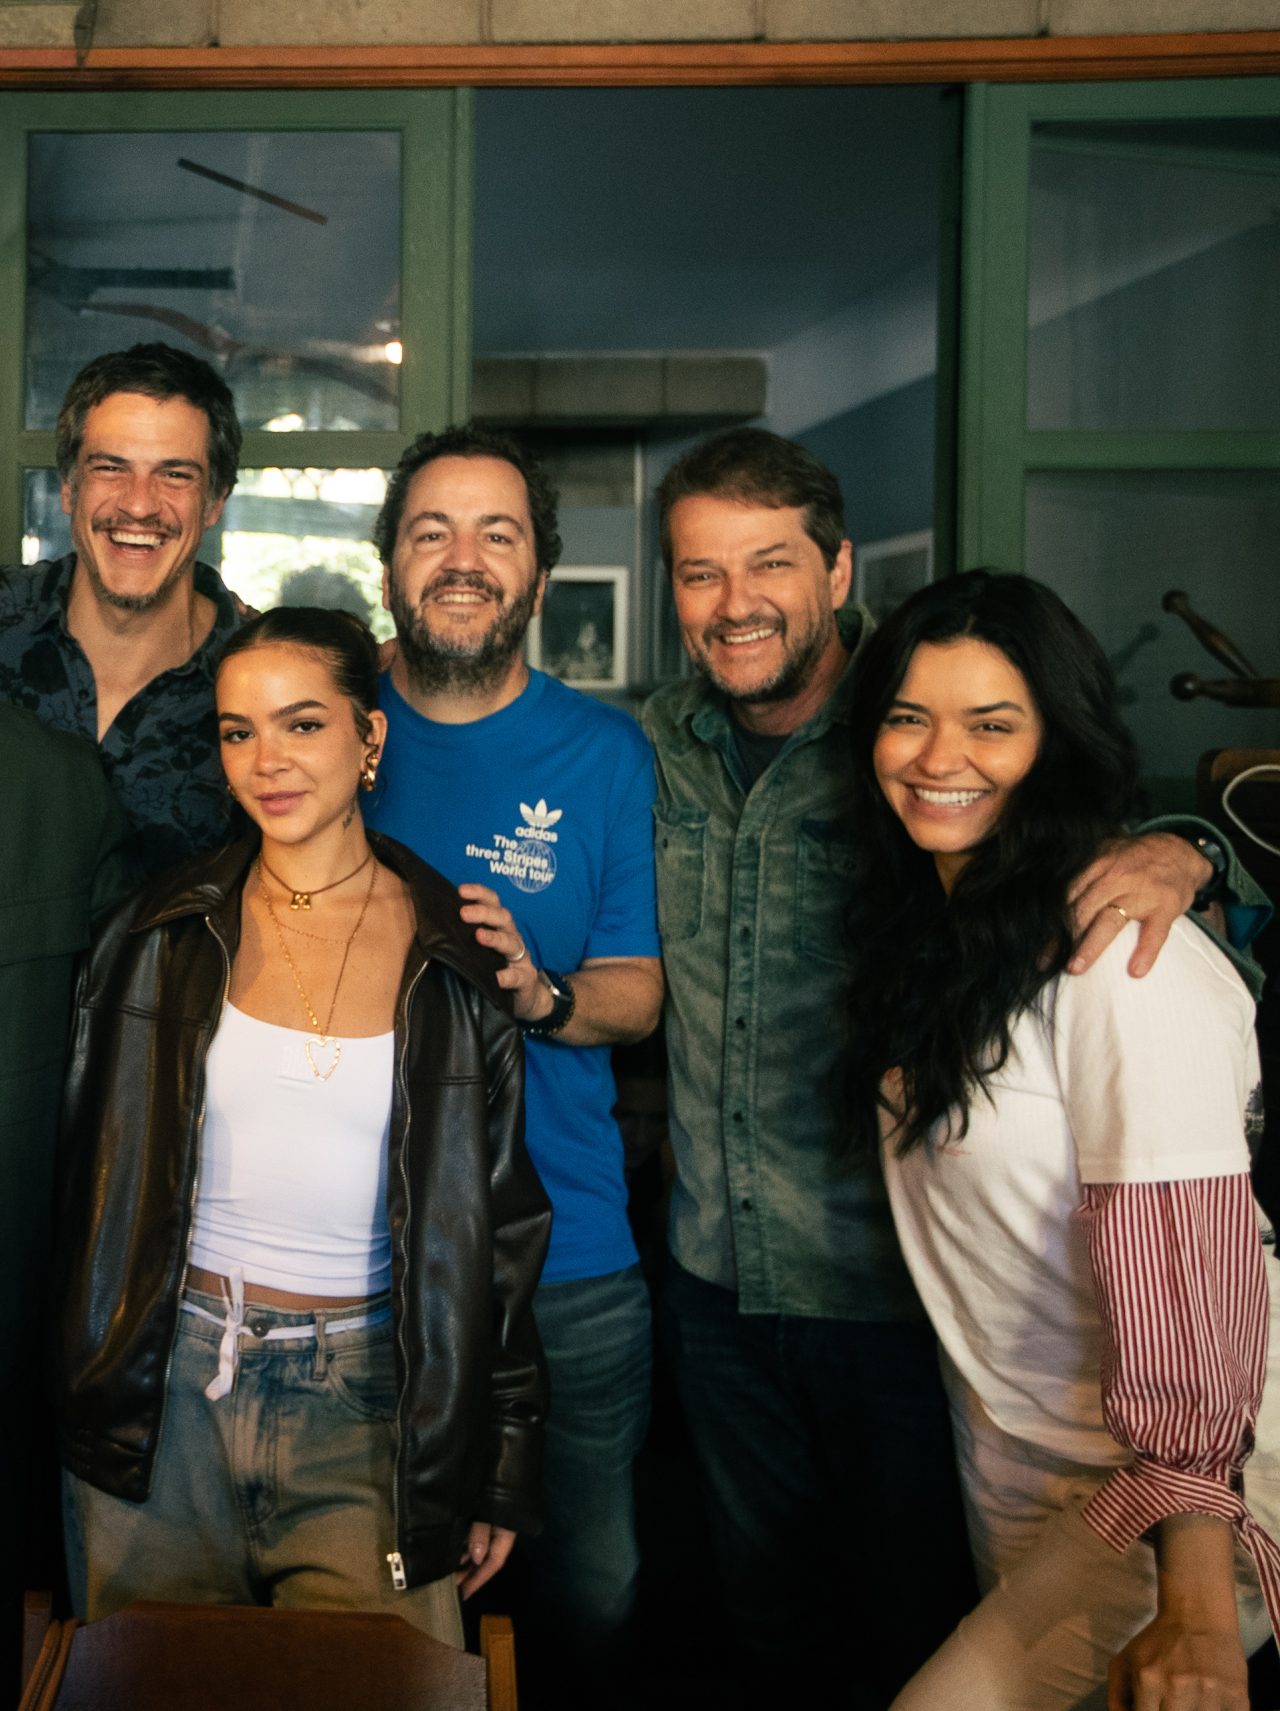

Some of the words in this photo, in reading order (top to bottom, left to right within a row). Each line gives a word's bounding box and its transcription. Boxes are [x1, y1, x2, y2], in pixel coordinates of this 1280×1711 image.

[493, 835, 518, 850] The
[515, 827, 558, 843] adidas
[465, 844, 501, 860] three
[504, 850, 548, 869] Stripes
[489, 861, 526, 879] World
[529, 868, 554, 883] tour
